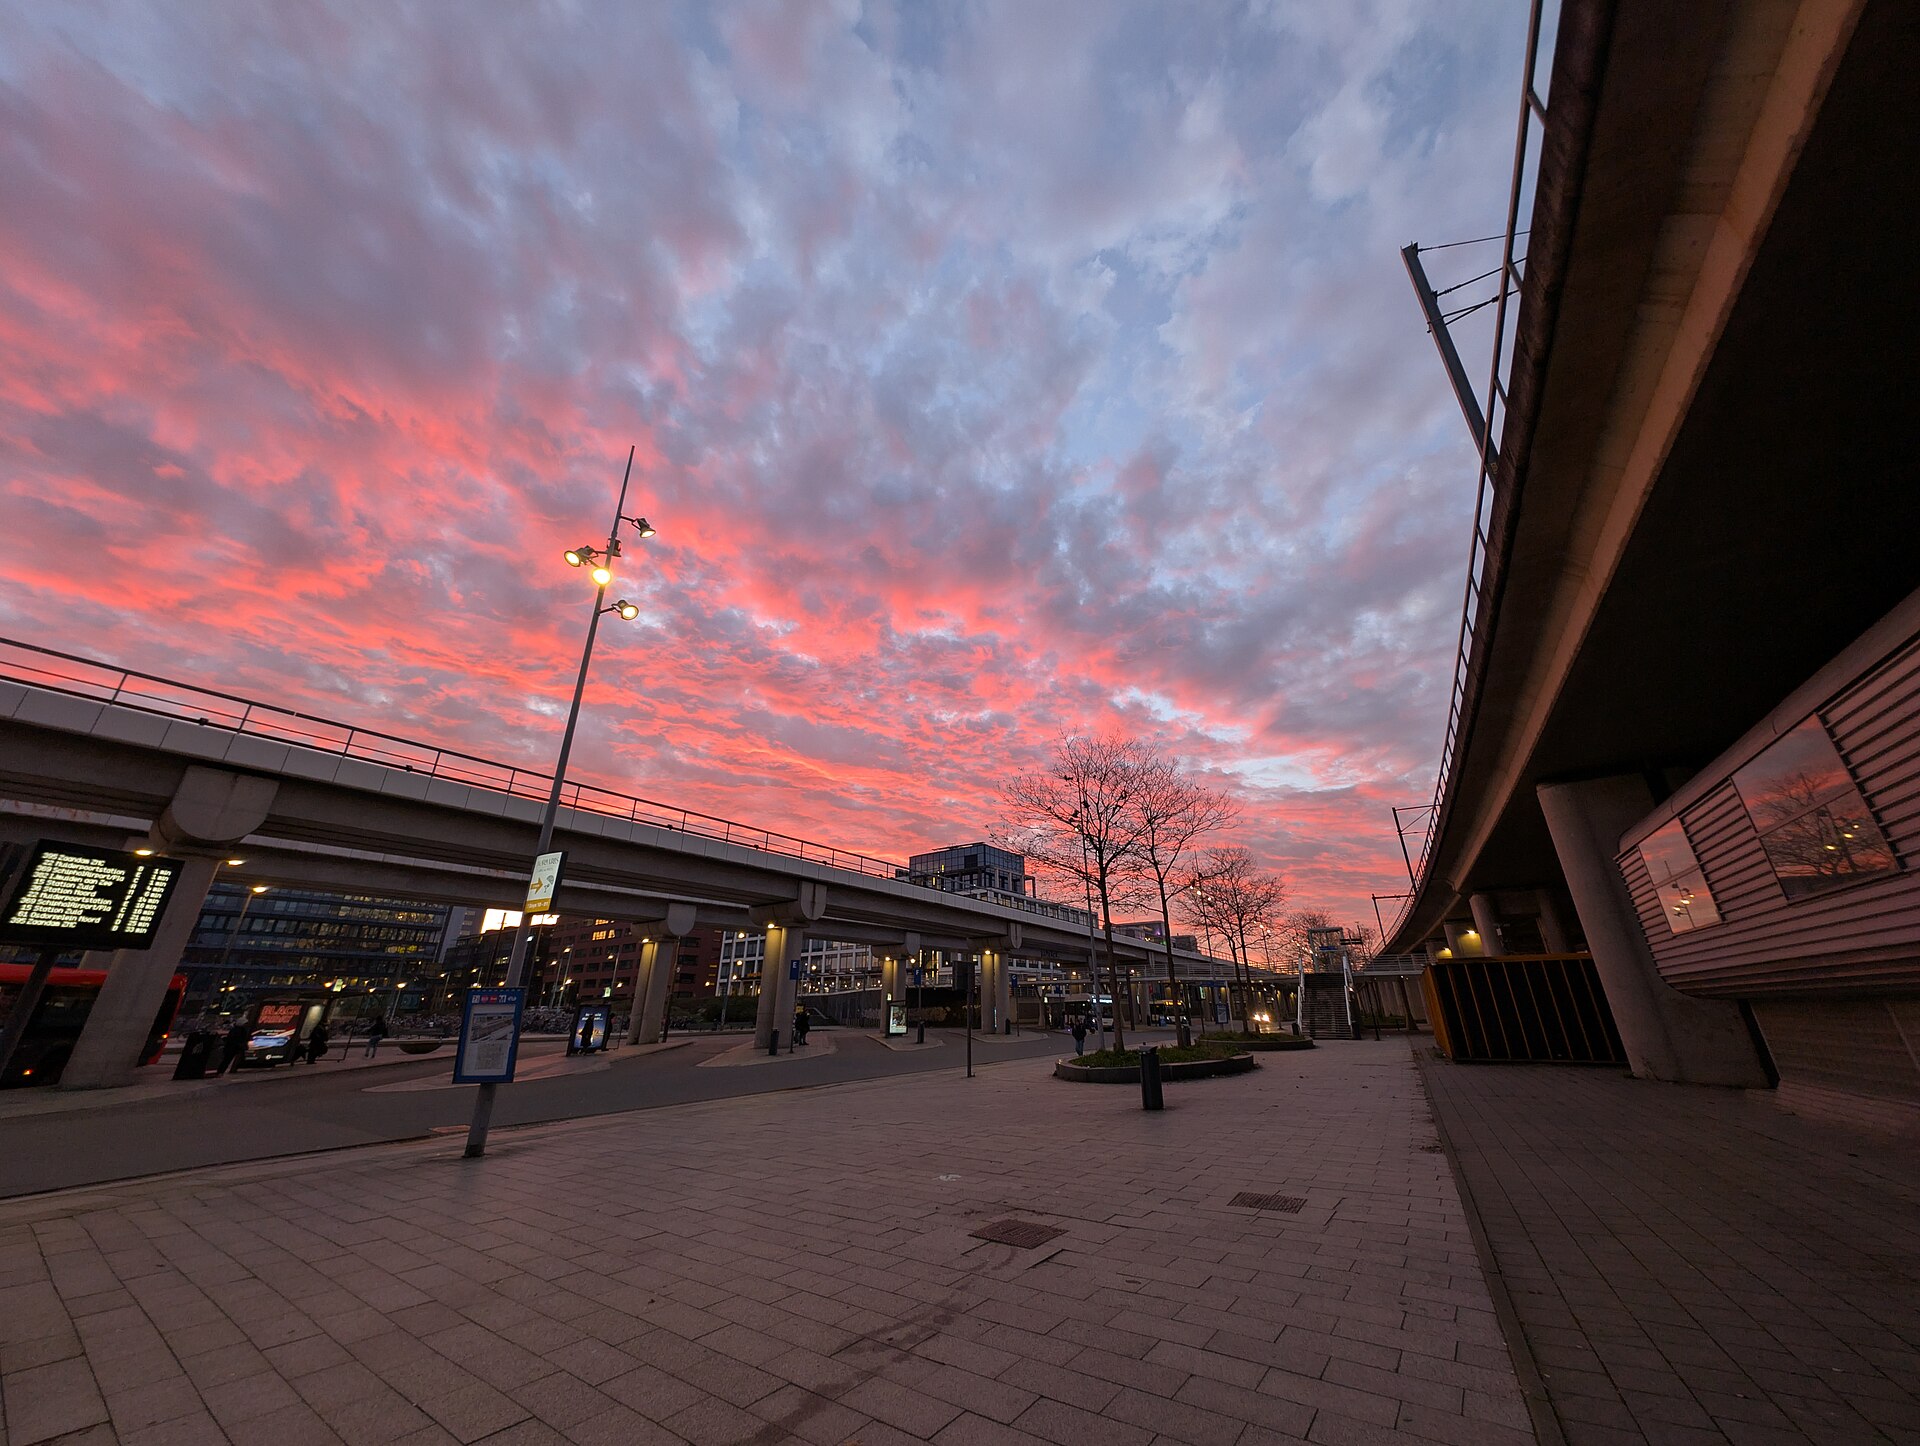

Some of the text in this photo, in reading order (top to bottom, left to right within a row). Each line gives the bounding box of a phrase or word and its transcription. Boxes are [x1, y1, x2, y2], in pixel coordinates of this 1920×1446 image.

[46, 880, 76, 888] Station
[43, 886, 73, 894] Station
[33, 905, 64, 913] Station
